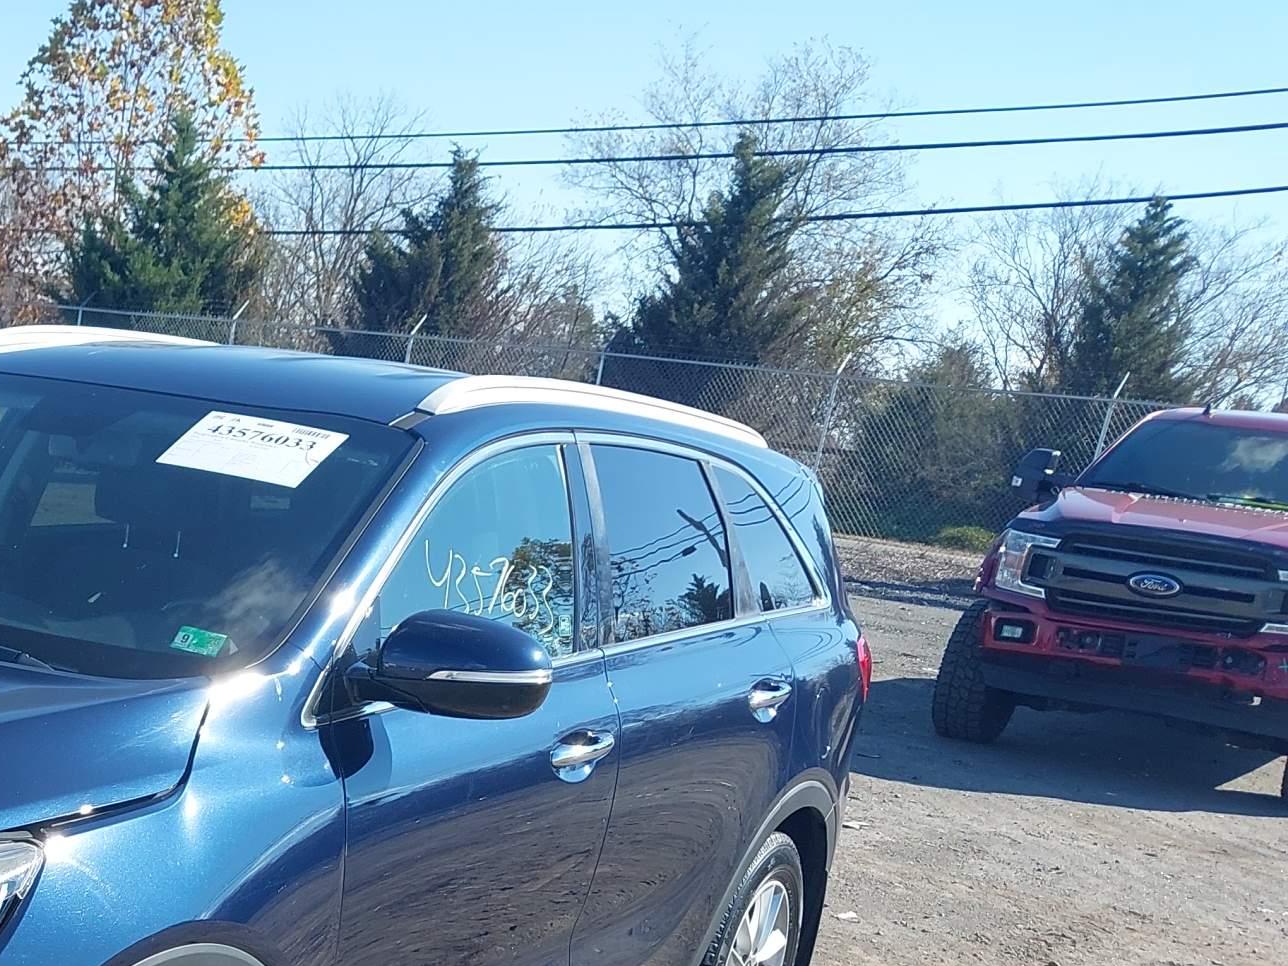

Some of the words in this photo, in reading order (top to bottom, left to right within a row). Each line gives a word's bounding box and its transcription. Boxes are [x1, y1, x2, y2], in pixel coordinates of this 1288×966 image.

[207, 423, 317, 450] 43576033
[425, 539, 554, 635] 43576033
[1140, 578, 1168, 591] Ford
[180, 633, 190, 643] 9
